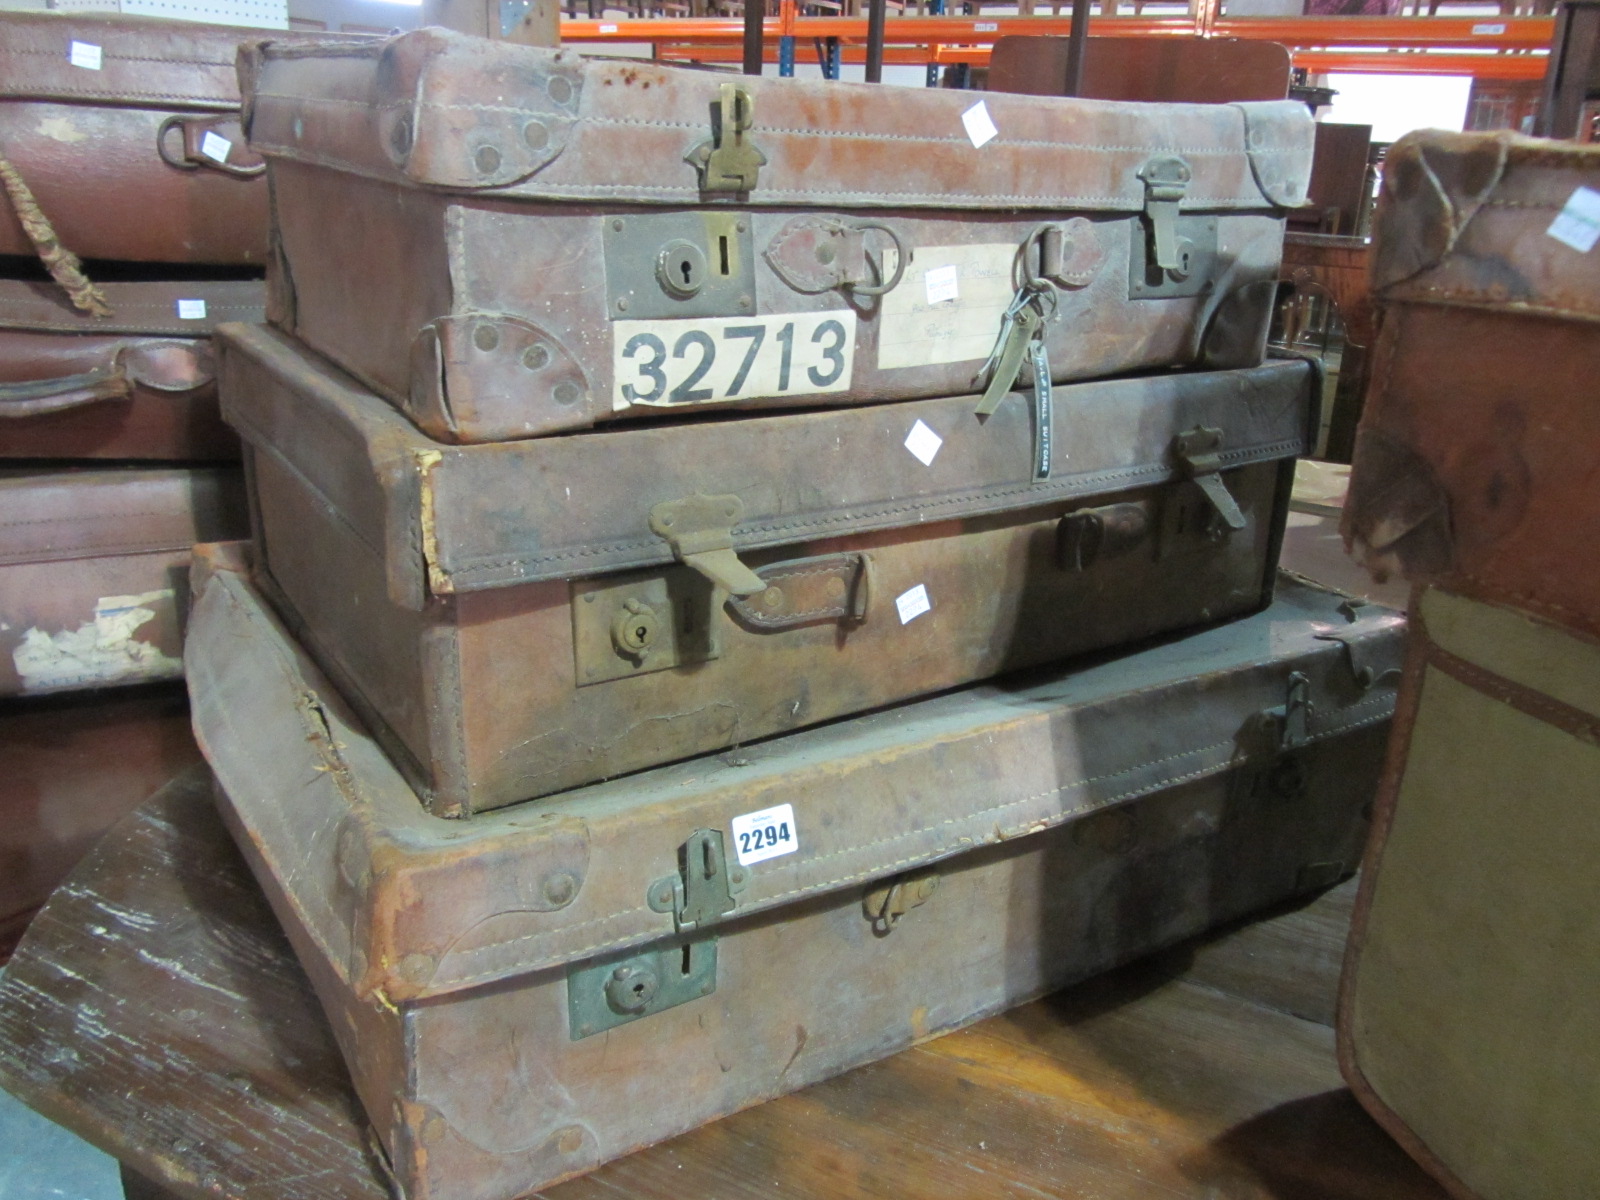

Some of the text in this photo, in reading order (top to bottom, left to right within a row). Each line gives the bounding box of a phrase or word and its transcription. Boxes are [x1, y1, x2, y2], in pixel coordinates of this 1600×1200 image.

[620, 319, 847, 403] 32713
[1041, 391, 1049, 420] SMALL
[1041, 426, 1050, 472] SUITCASE
[739, 822, 791, 855] 2294
